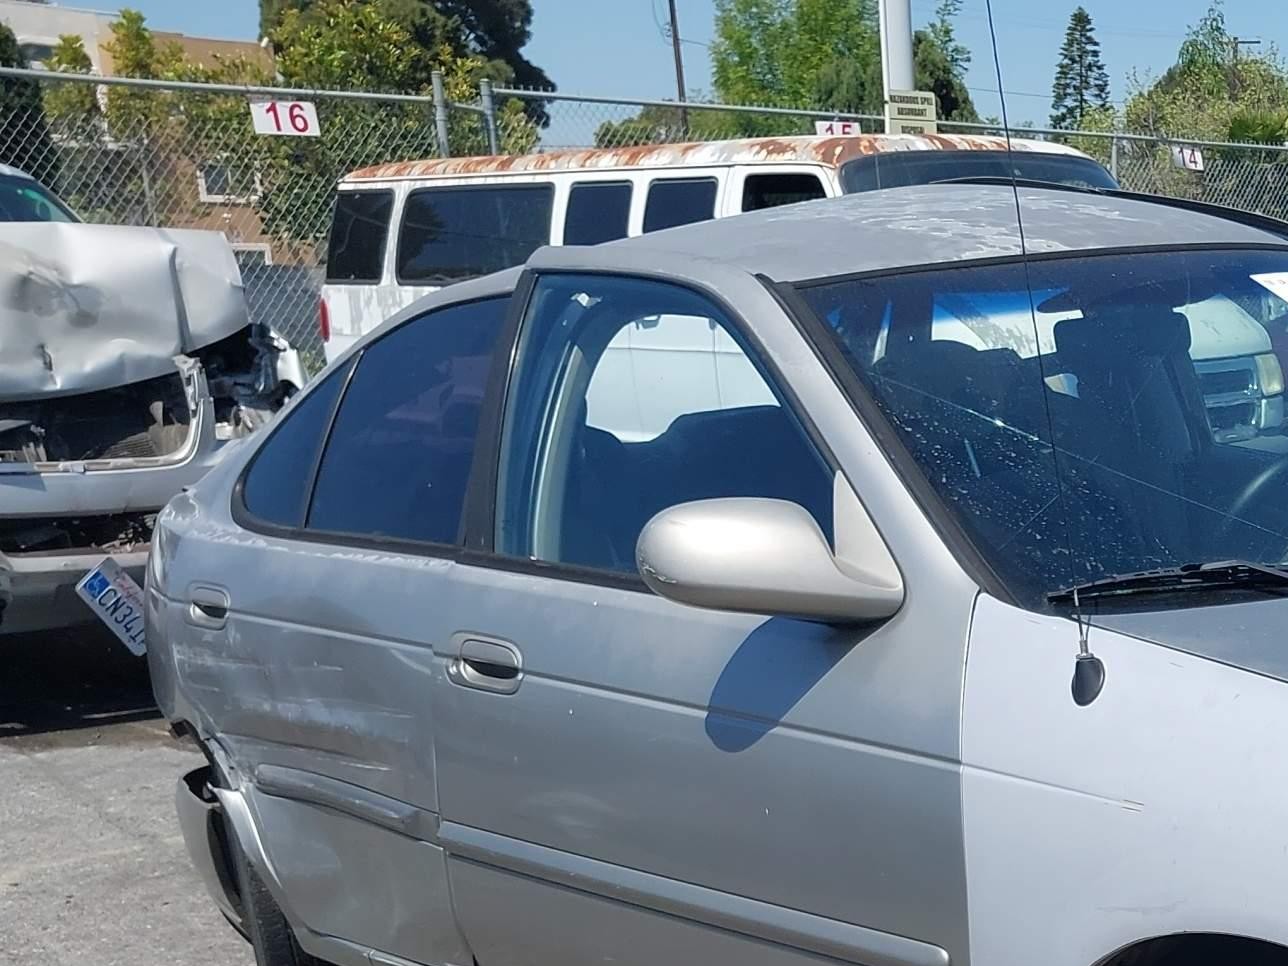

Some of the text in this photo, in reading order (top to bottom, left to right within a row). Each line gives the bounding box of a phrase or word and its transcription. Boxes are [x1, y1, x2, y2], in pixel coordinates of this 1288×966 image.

[265, 101, 309, 133] 16
[1178, 147, 1198, 168] 14
[98, 588, 145, 646] CN341
